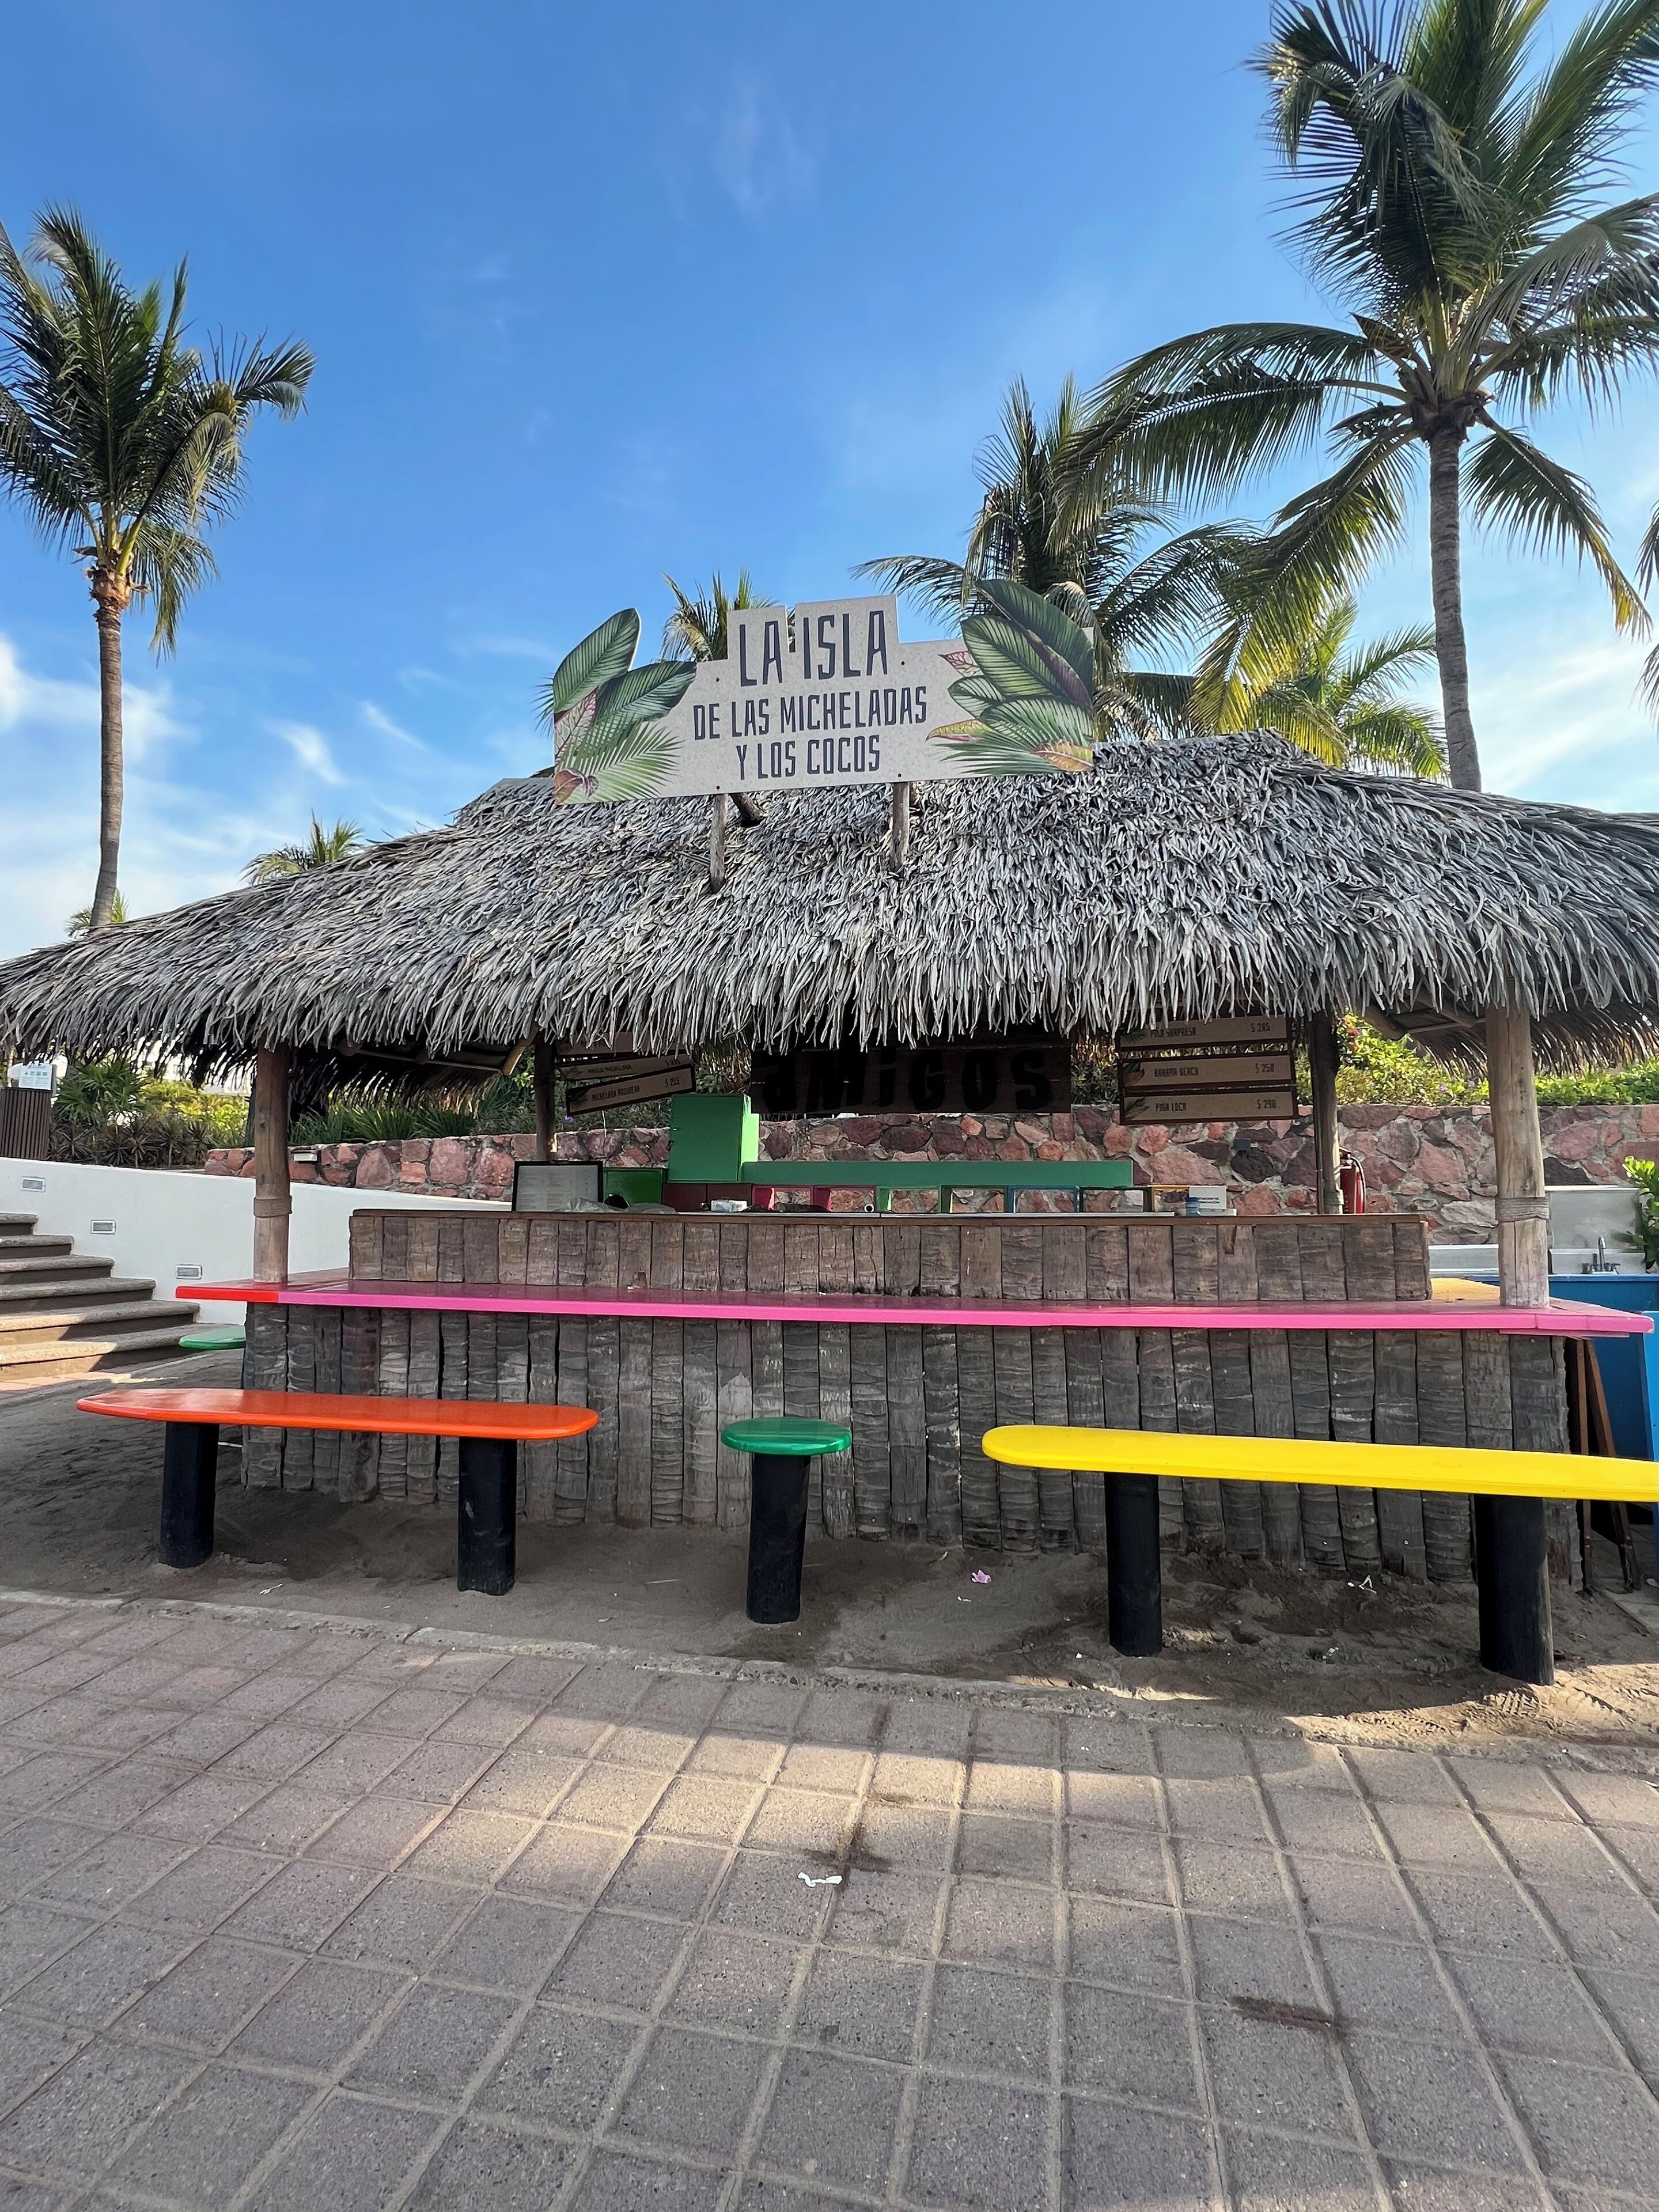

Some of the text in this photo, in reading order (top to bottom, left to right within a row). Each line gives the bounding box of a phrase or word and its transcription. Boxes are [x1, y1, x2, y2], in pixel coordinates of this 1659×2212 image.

[739, 610, 887, 687] LA ISLA
[694, 686, 926, 740] DE LAS MICHELADAS
[736, 735, 880, 780] Y LOS COCOS
